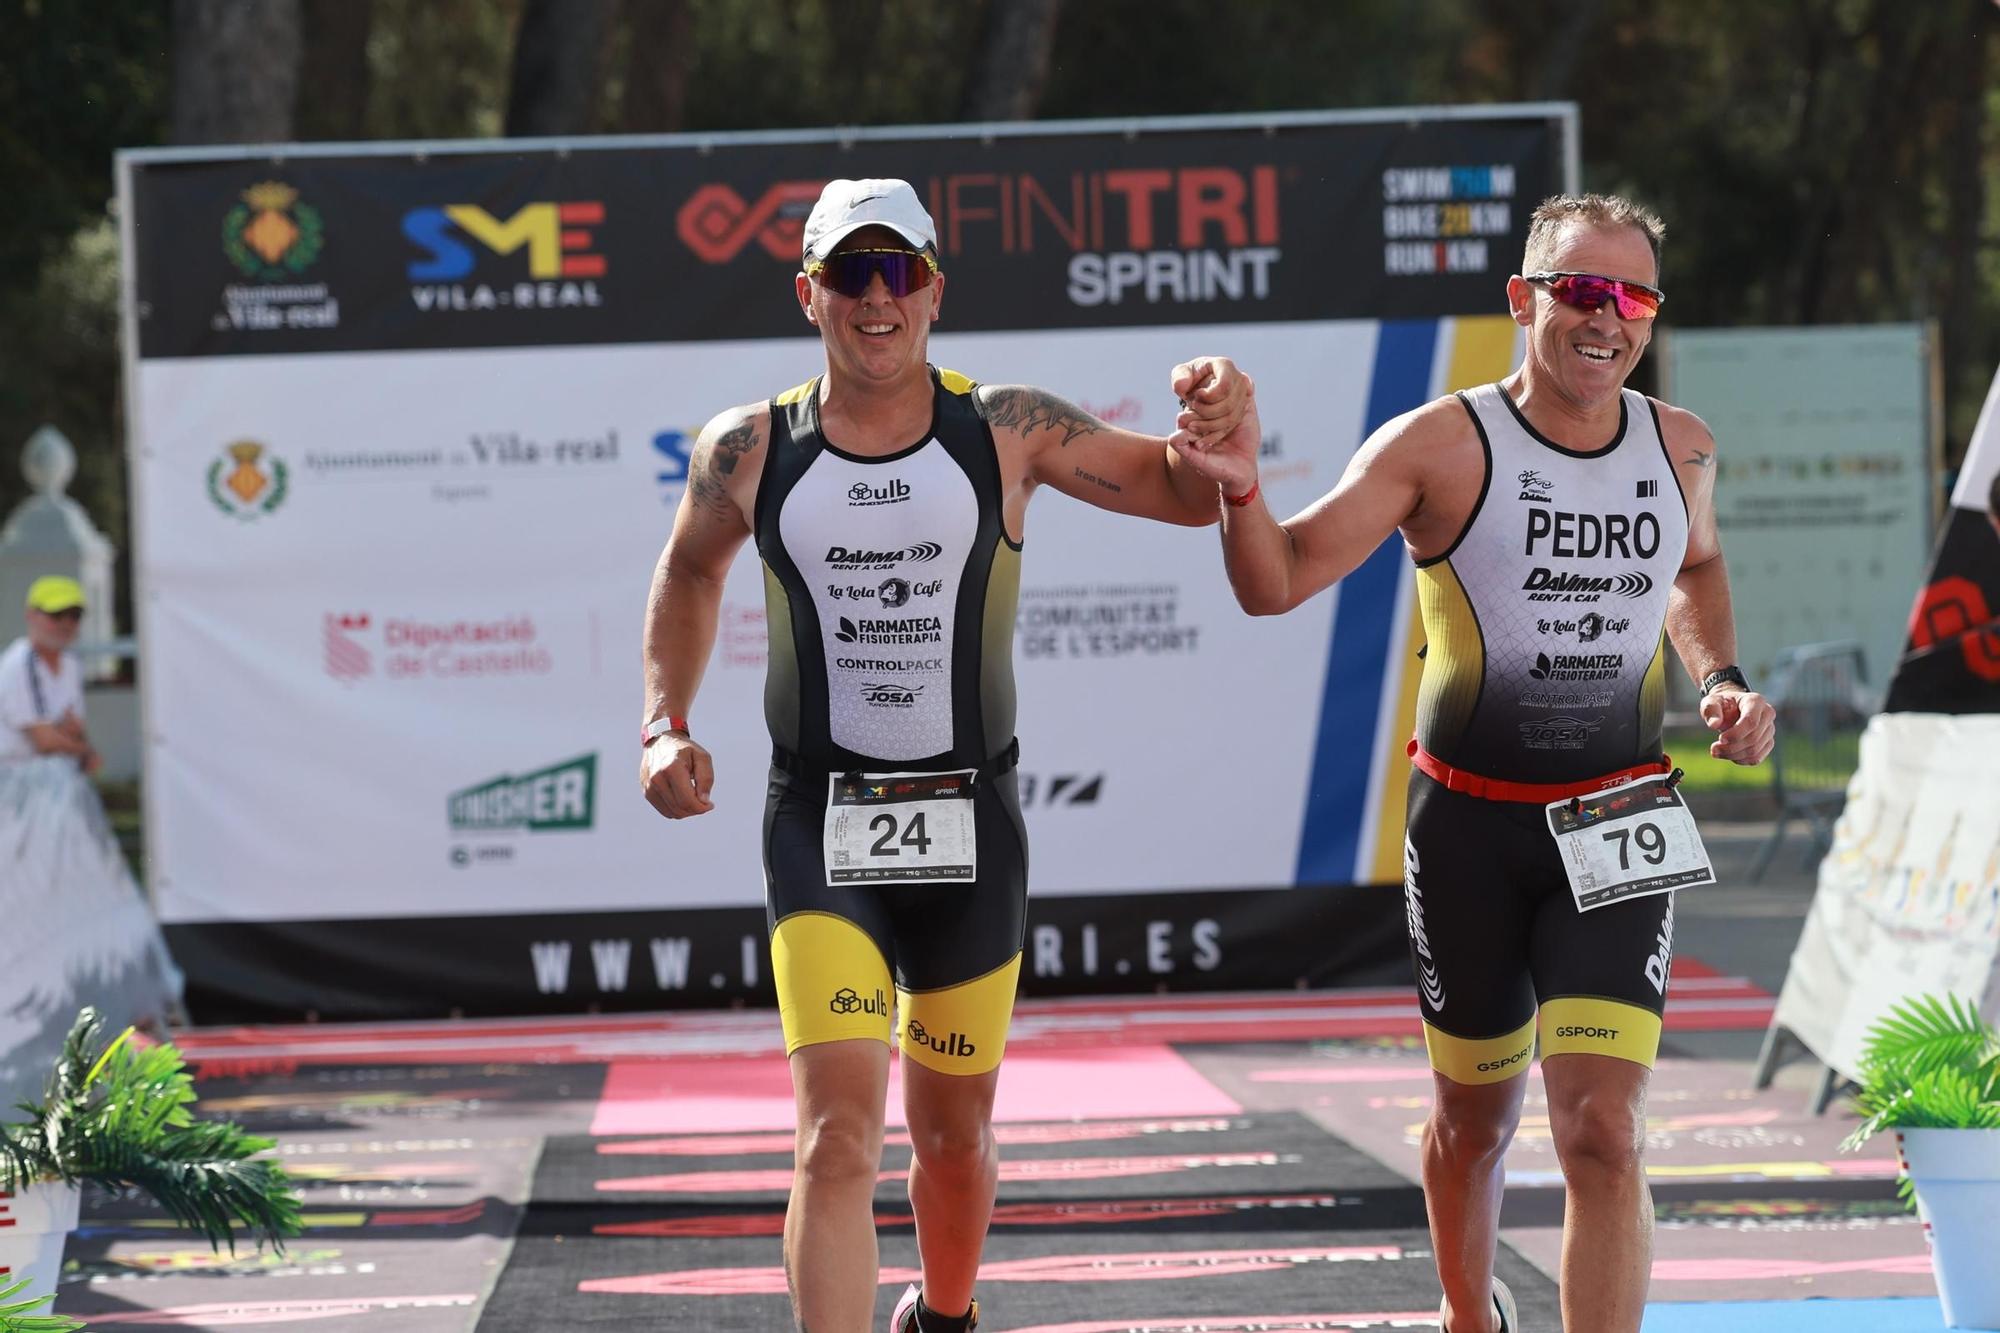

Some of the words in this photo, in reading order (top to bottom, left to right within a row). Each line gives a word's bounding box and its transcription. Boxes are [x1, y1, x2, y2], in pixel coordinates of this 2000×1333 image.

[930, 163, 1281, 254] FINITRI
[403, 201, 607, 281] SME
[1066, 247, 1280, 306] SPRINT
[411, 281, 602, 312] VILA-REAL
[468, 430, 619, 464] Vila-real
[1525, 507, 1661, 560] PEDRO
[861, 563, 870, 571] A
[873, 563, 896, 571] CAR
[827, 584, 843, 600] La
[846, 585, 875, 601] Lola
[913, 579, 943, 598] Café
[1527, 593, 1562, 603] RENT
[1563, 593, 1572, 603] A
[1574, 593, 1601, 603] CAR
[384, 611, 536, 649] Diputació
[859, 617, 942, 633] FARMATECA
[1536, 618, 1550, 635] La
[1552, 619, 1577, 636] Lola
[1605, 618, 1631, 635] Café
[859, 632, 942, 644] FISIOTERAPIA
[1023, 629, 1057, 659] DE
[836, 658, 943, 670] CONTROLPACK
[1552, 654, 1623, 669] FARMATECA
[1550, 669, 1618, 681] FISIOTERAPIA
[865, 692, 914, 702] JOSA
[1520, 691, 1611, 704] CONTROLPACK
[1523, 727, 1588, 741] JOSA
[934, 787, 959, 796] SPRINT
[868, 812, 932, 857] 24
[1602, 822, 1667, 871] 79
[1556, 1026, 1620, 1040] GSPORT
[1477, 1042, 1533, 1072] GSPORT
